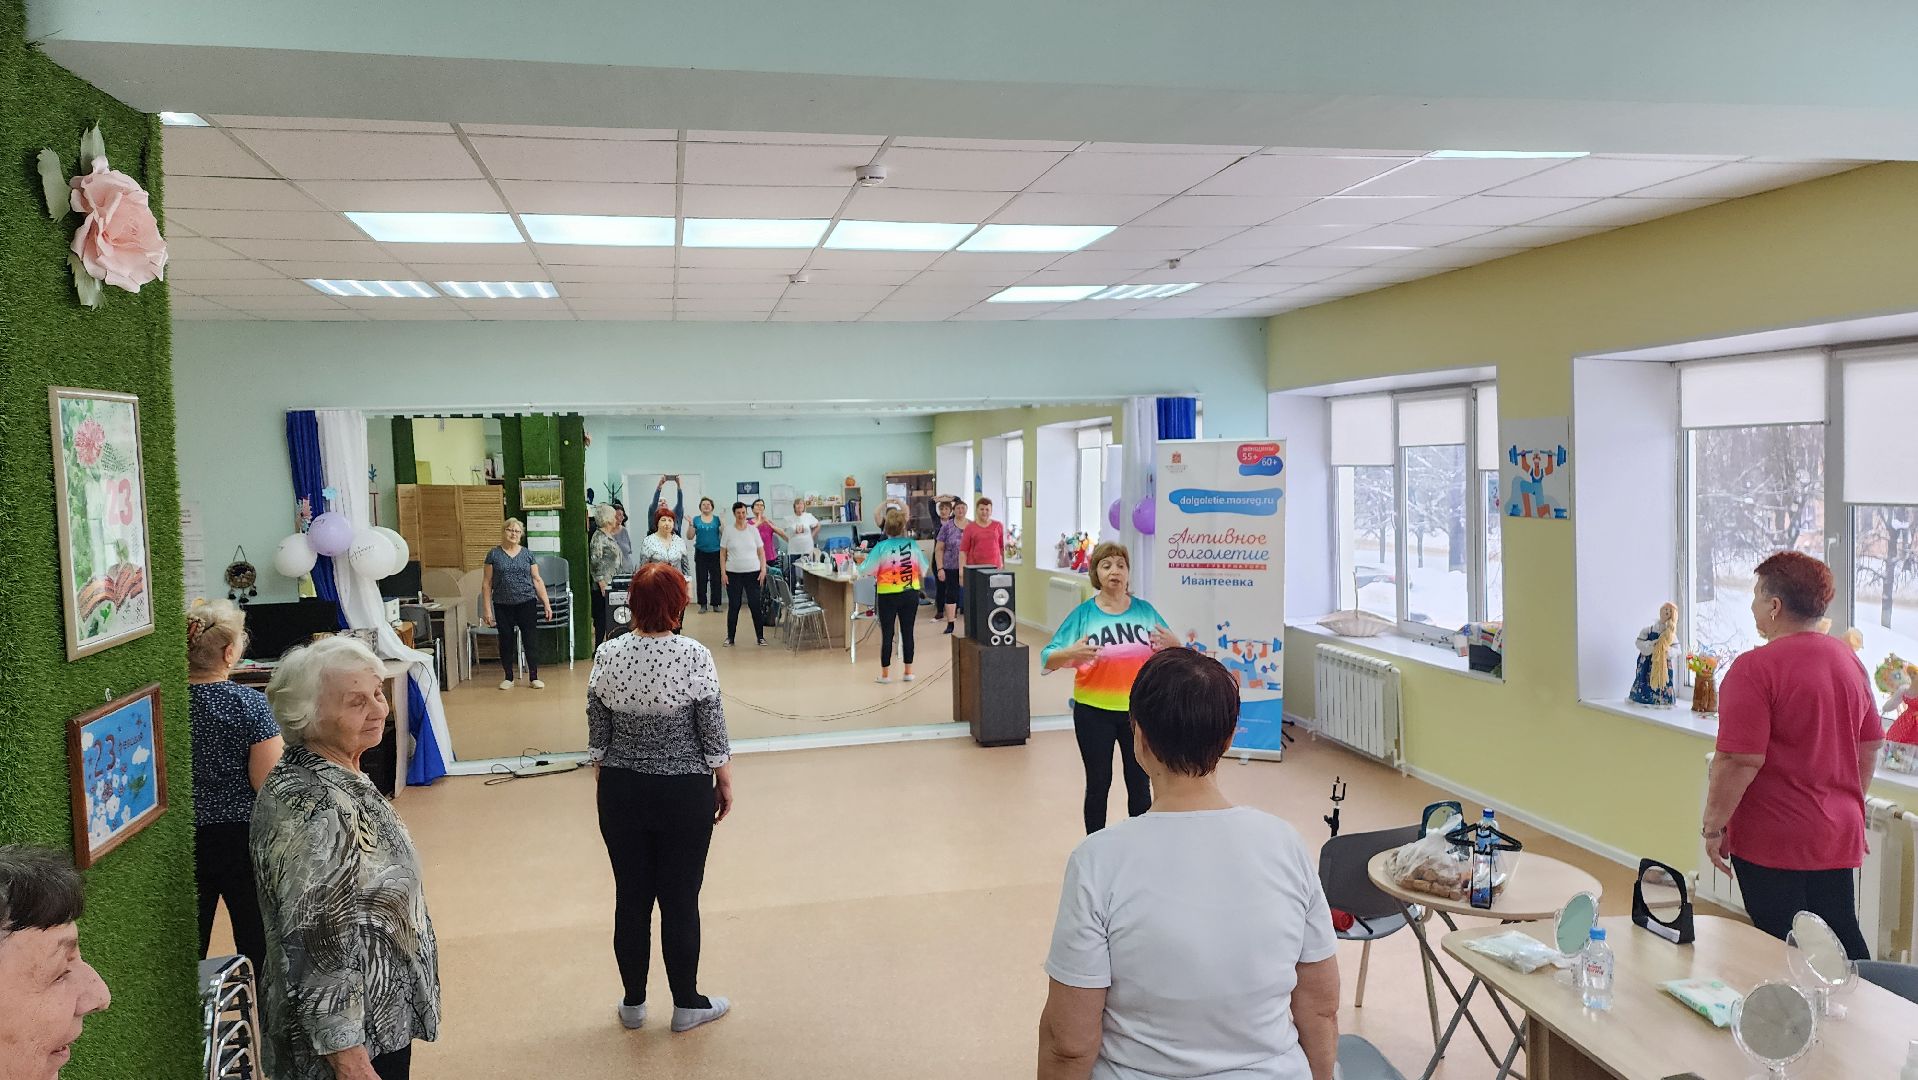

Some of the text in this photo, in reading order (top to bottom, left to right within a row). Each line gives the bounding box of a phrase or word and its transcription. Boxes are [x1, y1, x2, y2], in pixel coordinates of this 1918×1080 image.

[1242, 452, 1258, 461] 55+
[1262, 457, 1278, 466] 60+
[1180, 495, 1274, 507] dolgoletie.mosreg.ru
[1168, 528, 1267, 545] Активное
[1168, 542, 1269, 561] долголетие
[1181, 575, 1254, 587] Ивантеевка
[1085, 622, 1151, 647] DANC
[92, 733, 116, 778] 23
